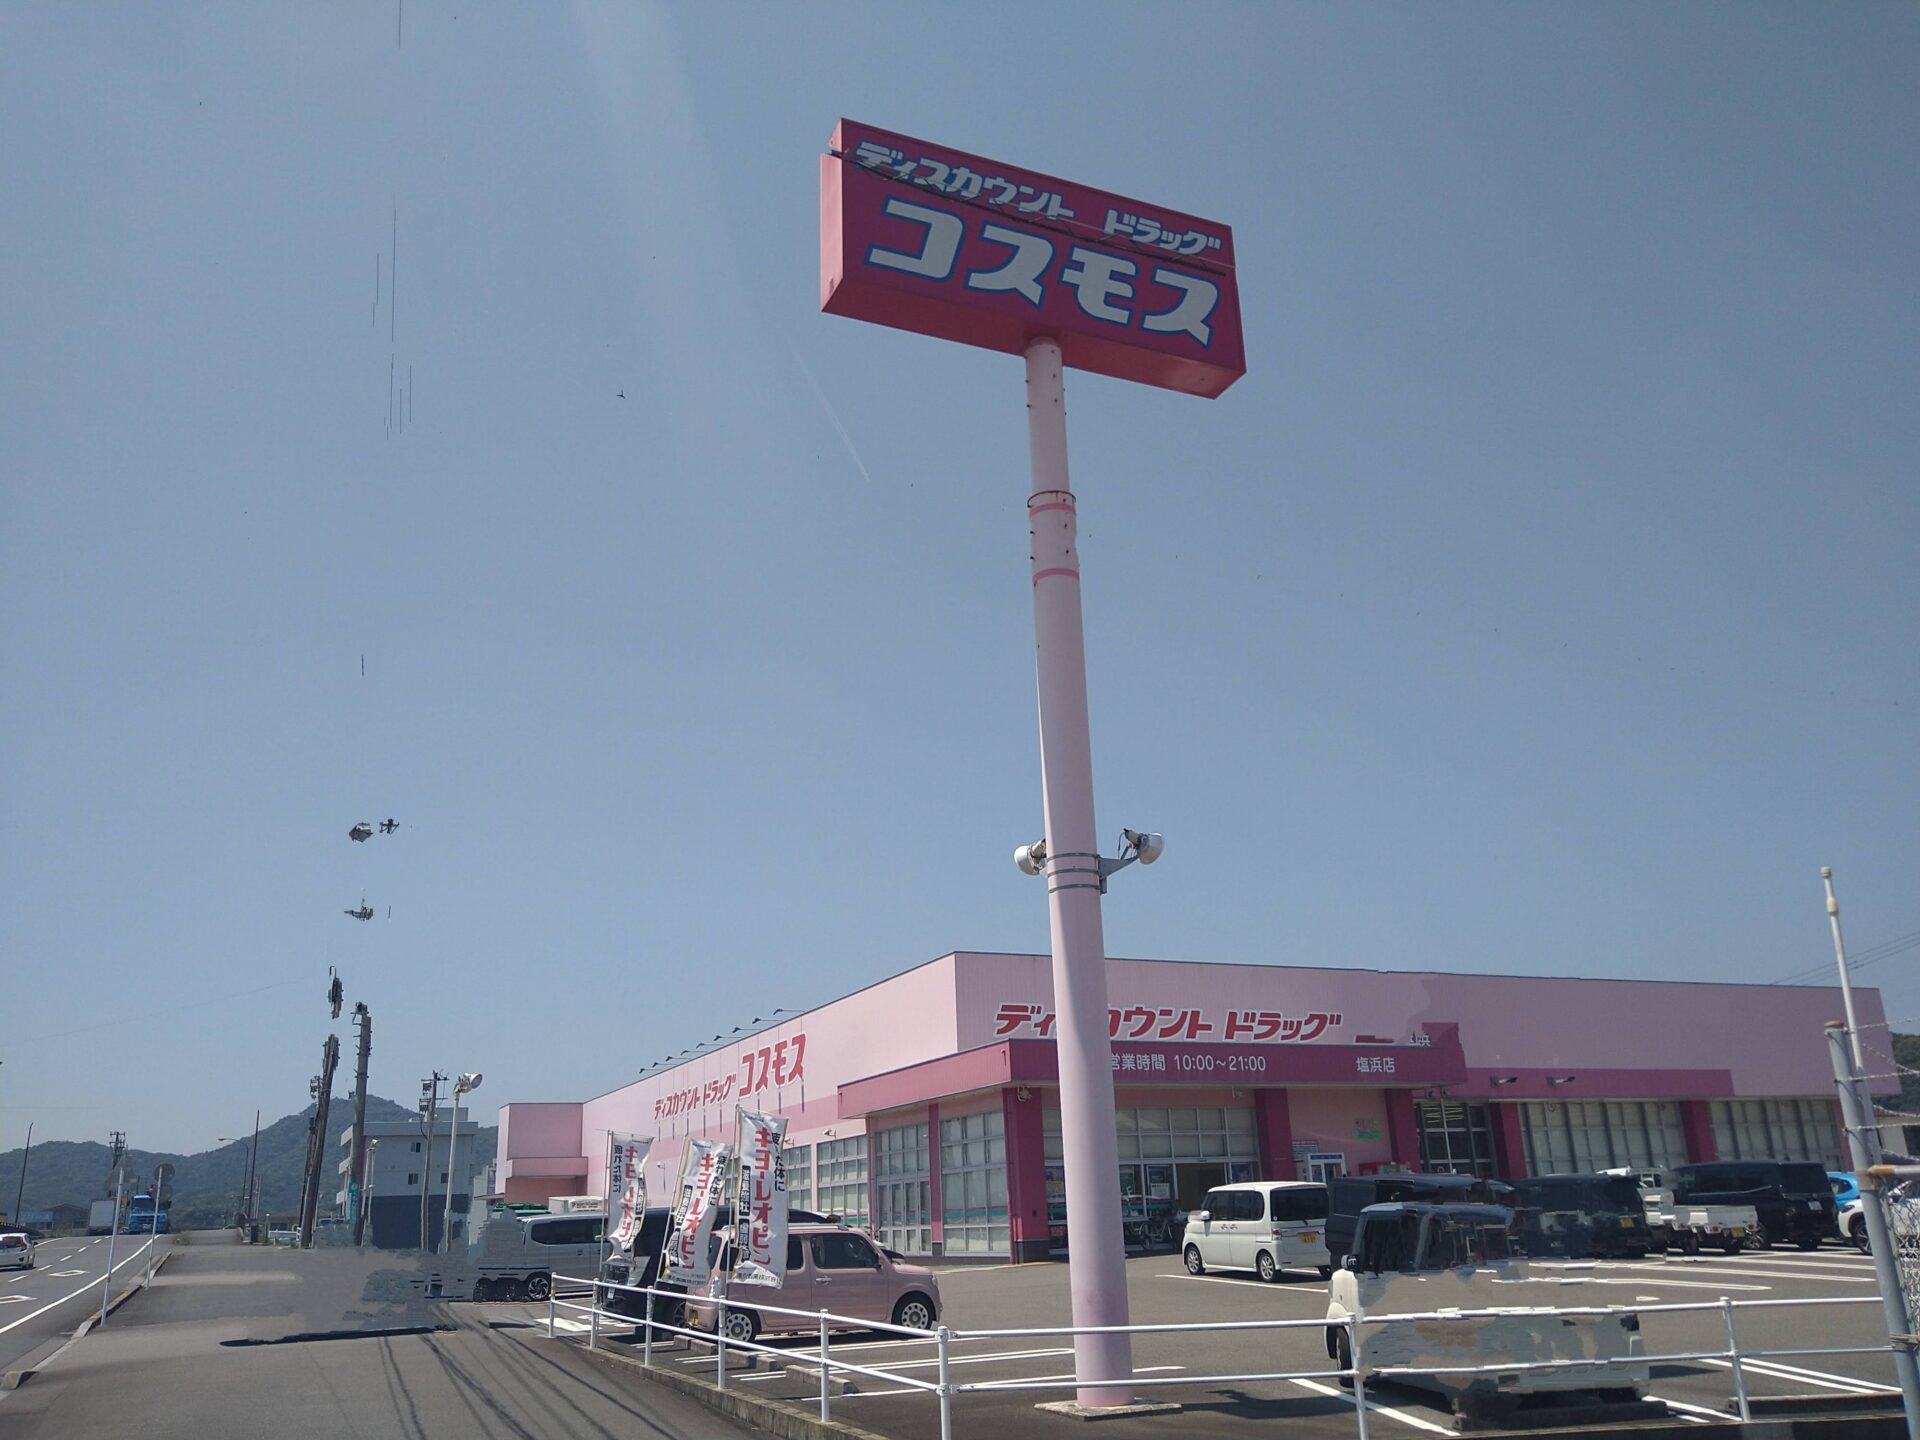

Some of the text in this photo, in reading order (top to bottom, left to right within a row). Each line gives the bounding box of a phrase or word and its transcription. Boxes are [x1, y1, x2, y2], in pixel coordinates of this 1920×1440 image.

[855, 141, 1221, 255] ディスカウント ドラッグ
[869, 199, 1218, 346] コスモス
[996, 1004, 1342, 1041] ディウント ドラッグ
[1356, 1056, 1396, 1073] 塩浜店
[655, 1033, 806, 1120] ディスカウント ドラッグ コスモス
